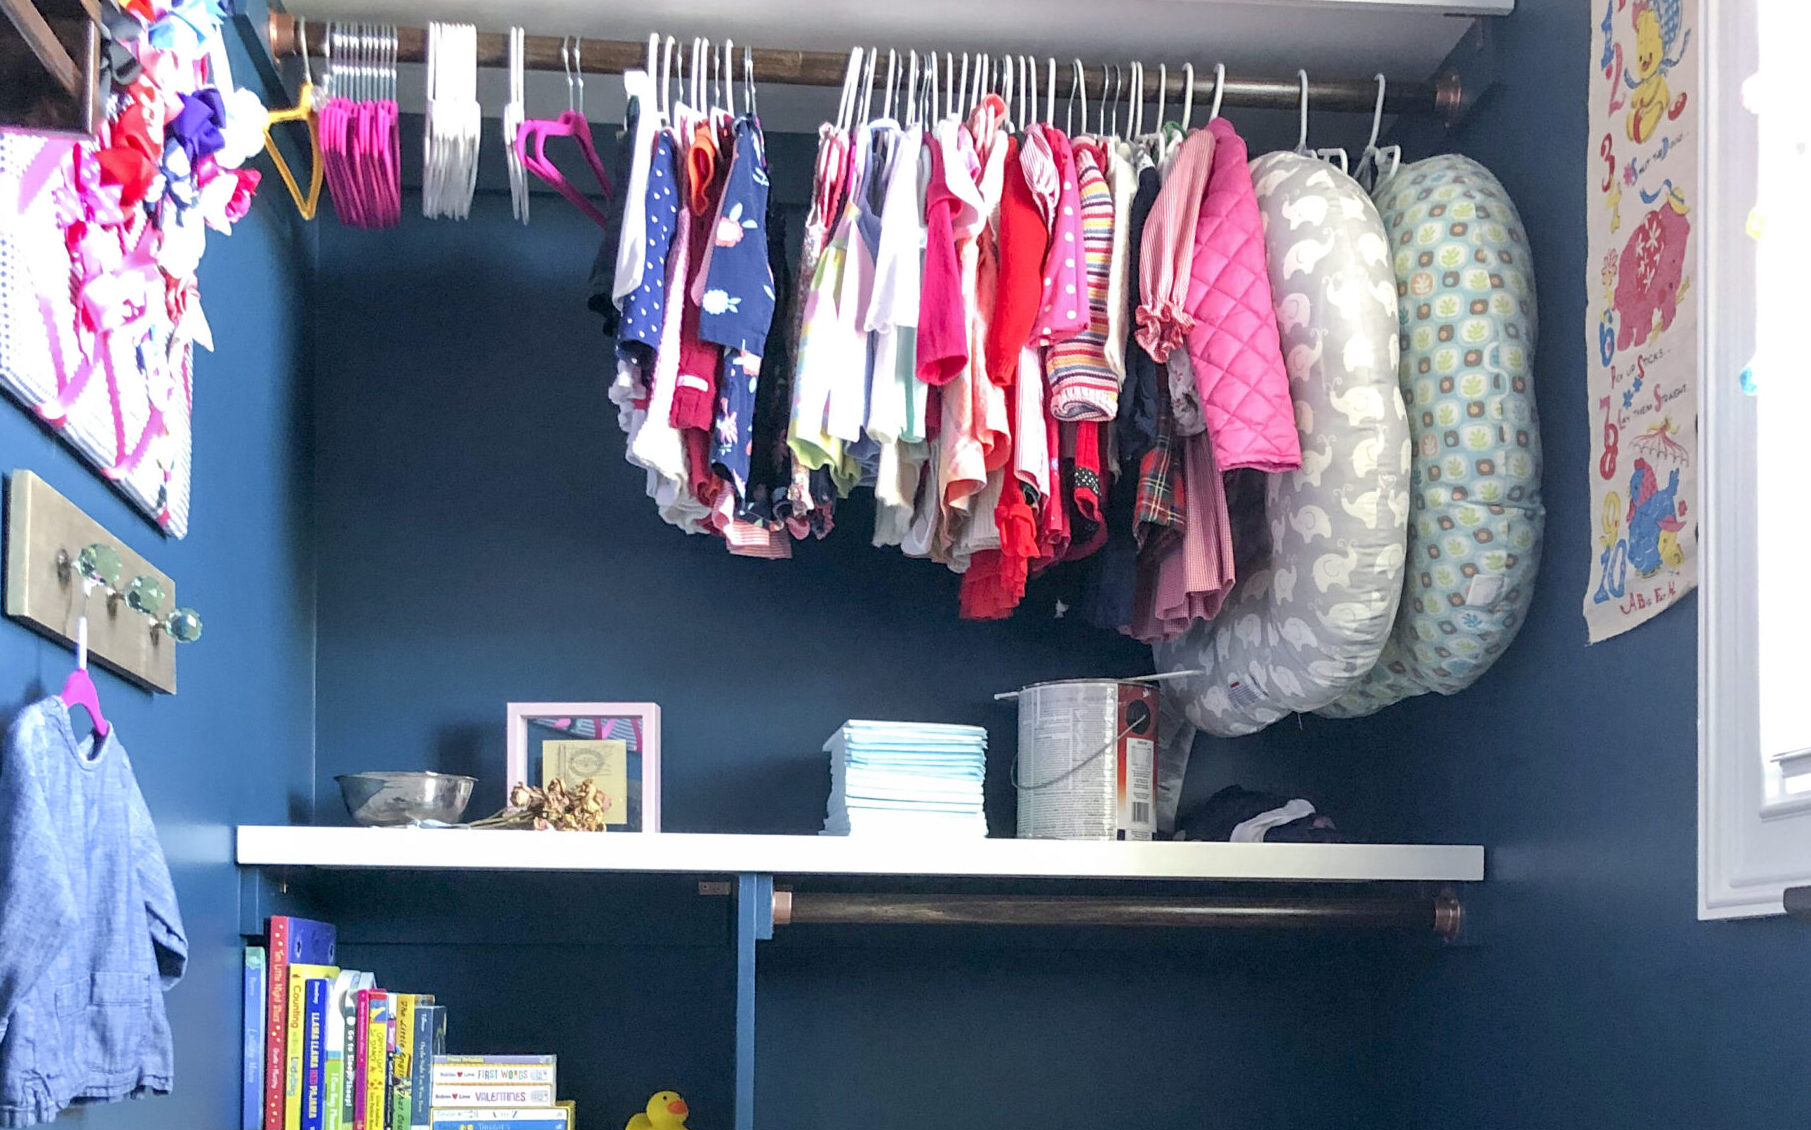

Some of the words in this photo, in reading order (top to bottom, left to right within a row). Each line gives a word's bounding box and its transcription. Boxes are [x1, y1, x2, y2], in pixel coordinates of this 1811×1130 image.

[1605, 42, 1627, 118] 2
[1600, 132, 1616, 193] 3
[1599, 308, 1615, 368] 6
[1600, 423, 1619, 481] 8
[1600, 491, 1622, 549] 9
[1594, 538, 1628, 605] 10
[290, 985, 301, 1029] Counting
[311, 1012, 320, 1041] LLAMA
[347, 1030, 355, 1042] Go
[399, 1019, 408, 1049] Little
[310, 1041, 319, 1069] LLAMA
[347, 1043, 355, 1053] to
[477, 1069, 498, 1080] FIRST
[308, 1085, 318, 1119] PAJAMA
[475, 1091, 526, 1102] VALENTINES
